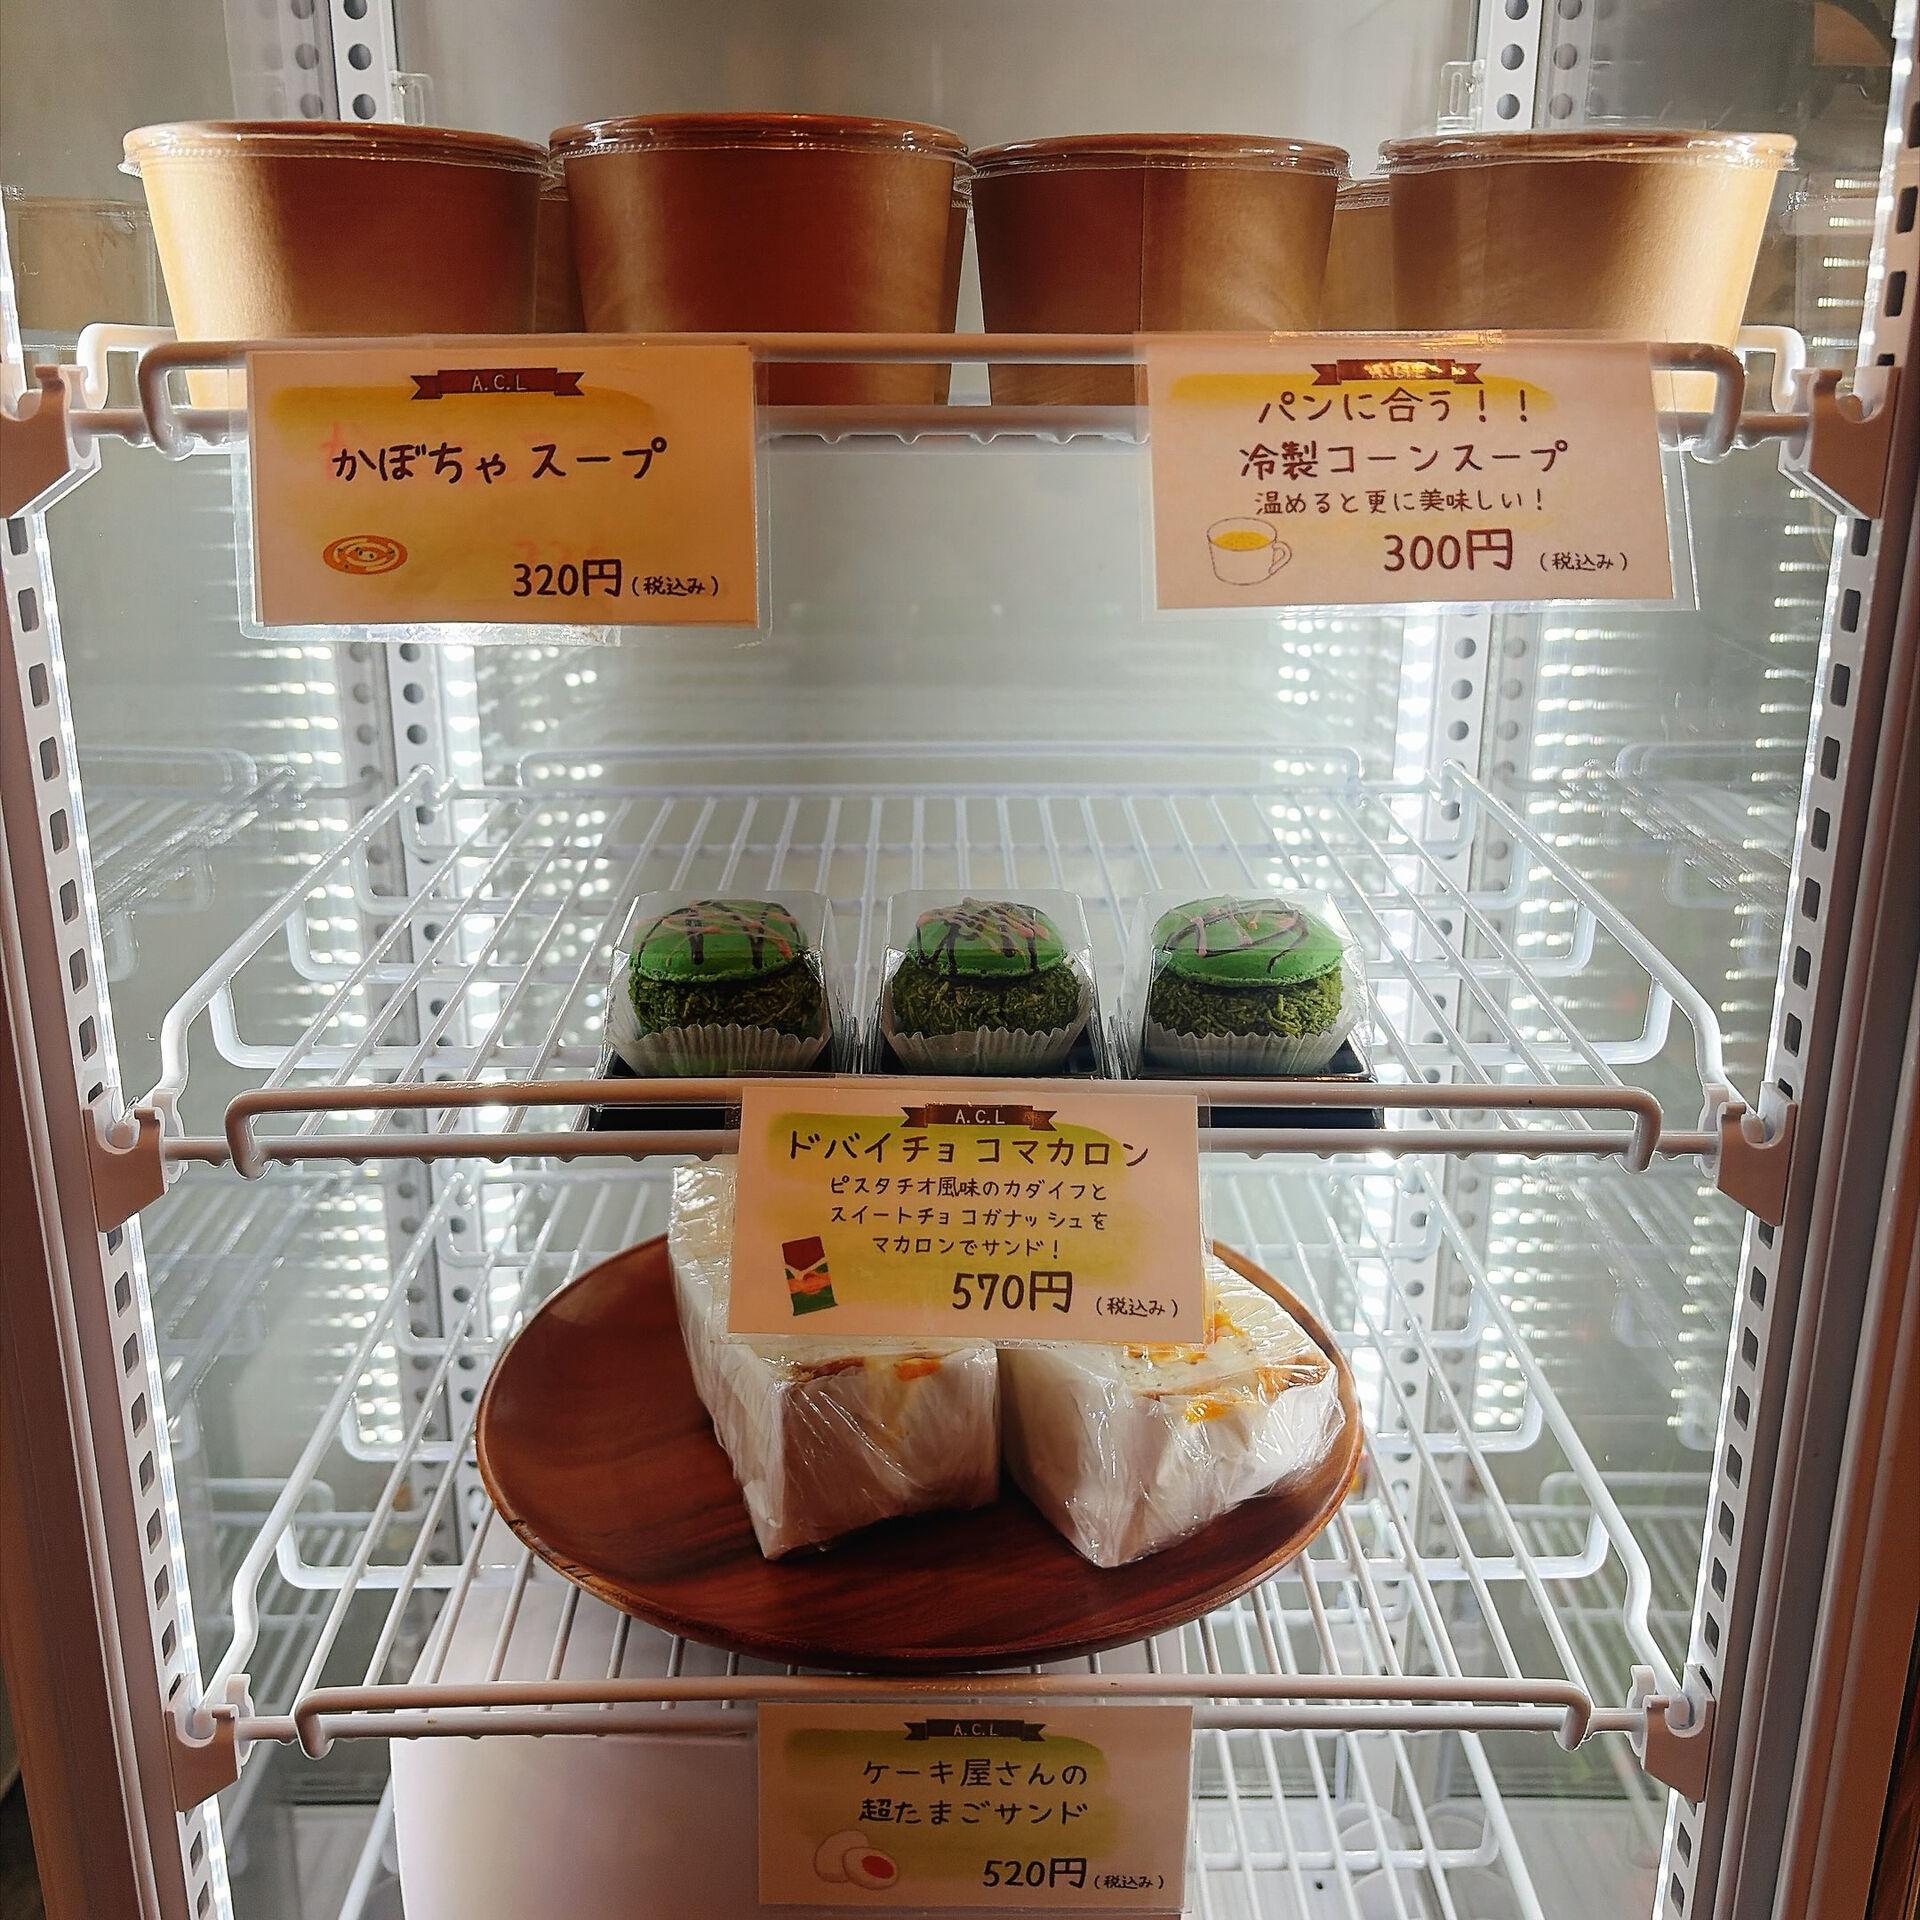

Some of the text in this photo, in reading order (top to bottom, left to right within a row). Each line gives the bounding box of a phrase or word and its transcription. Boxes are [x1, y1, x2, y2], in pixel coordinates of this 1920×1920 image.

[471, 372, 527, 393] A.C.L
[1257, 388, 1530, 424] パンに合う！！
[1239, 439, 1568, 479] 冷製コーンスープ
[1255, 488, 1544, 515] 温めると更に美味しい！
[1383, 528, 1628, 572] 300円 （税込み）
[513, 558, 719, 597] 320円 （税込み）
[955, 1109, 1005, 1125] A.C.L
[789, 1130, 1149, 1167] ドバイチョコマカロン
[831, 1176, 1108, 1202] ピスタチオ風味のカダイフと
[831, 1206, 1108, 1231] スイートチョコガナッシュを
[872, 1236, 1060, 1260] マカロンでサンド！
[951, 1270, 1180, 1318] 570円 （税込み）
[953, 1723, 999, 1737] A.C.L
[862, 1758, 1088, 1787] ケーキ屋さんの
[858, 1798, 1088, 1825] 超たまごサンド
[982, 1857, 1164, 1890] 520円 （税込み）
